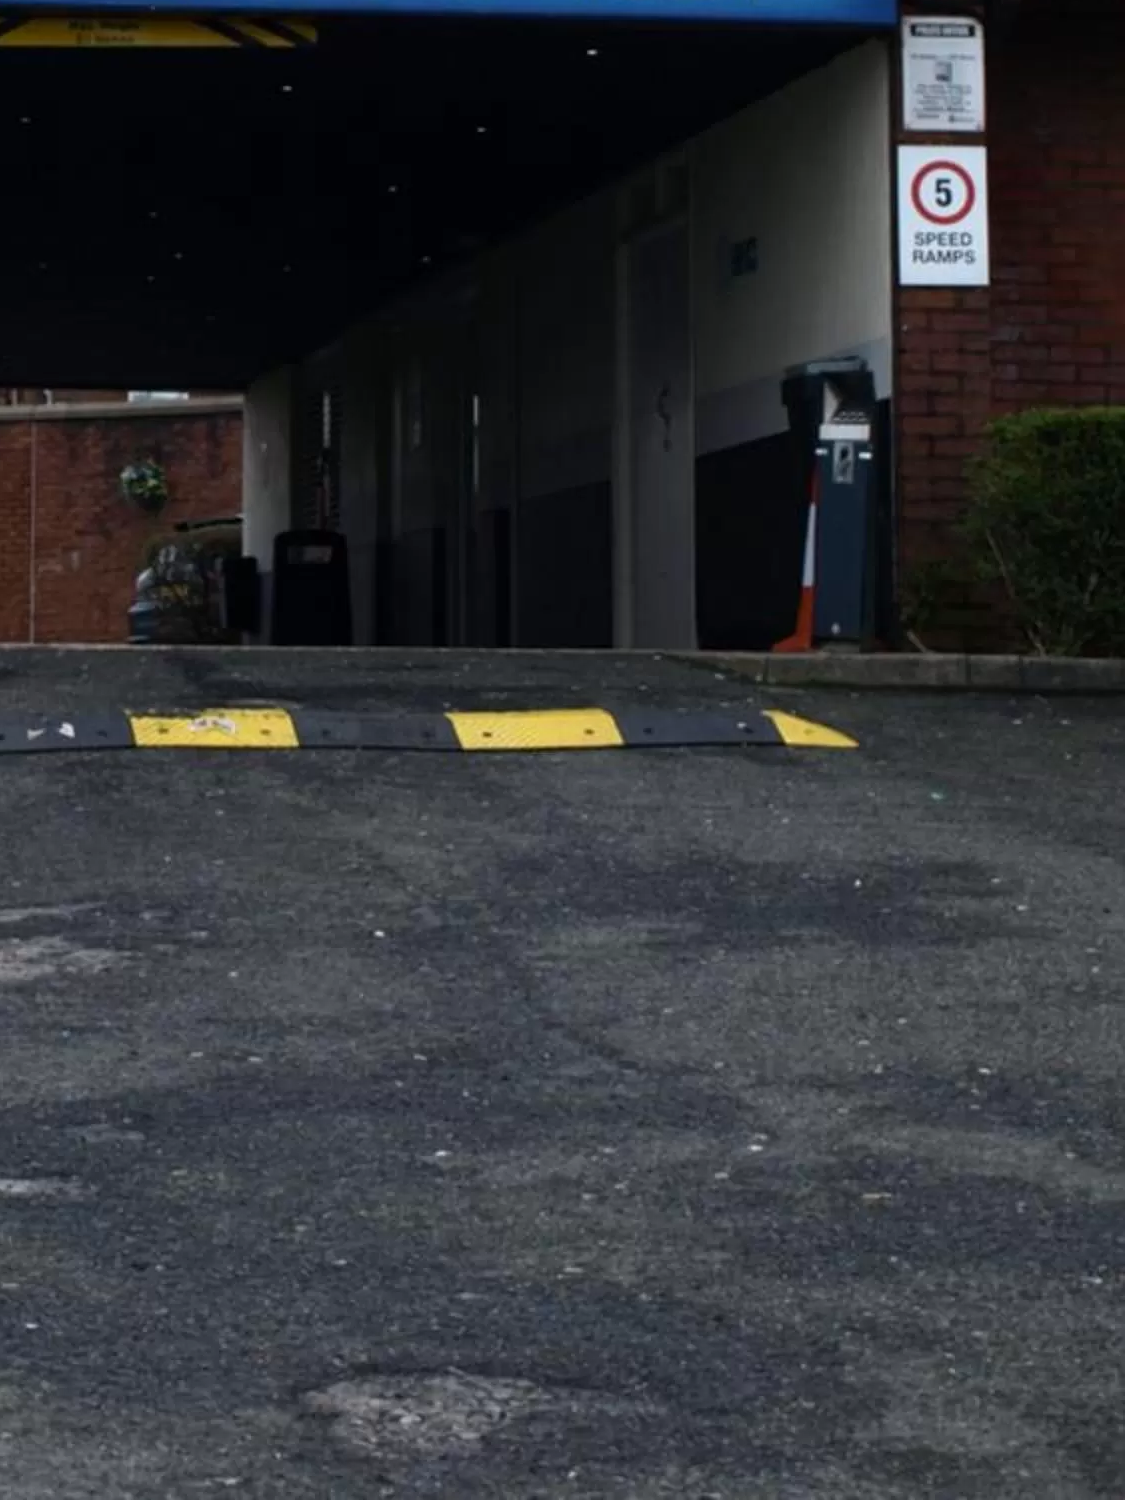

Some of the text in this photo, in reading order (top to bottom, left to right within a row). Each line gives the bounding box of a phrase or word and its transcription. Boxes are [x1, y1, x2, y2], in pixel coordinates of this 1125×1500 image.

[935, 178, 952, 207] 5
[914, 232, 973, 246] SPEED
[912, 249, 976, 264] RAMPS
